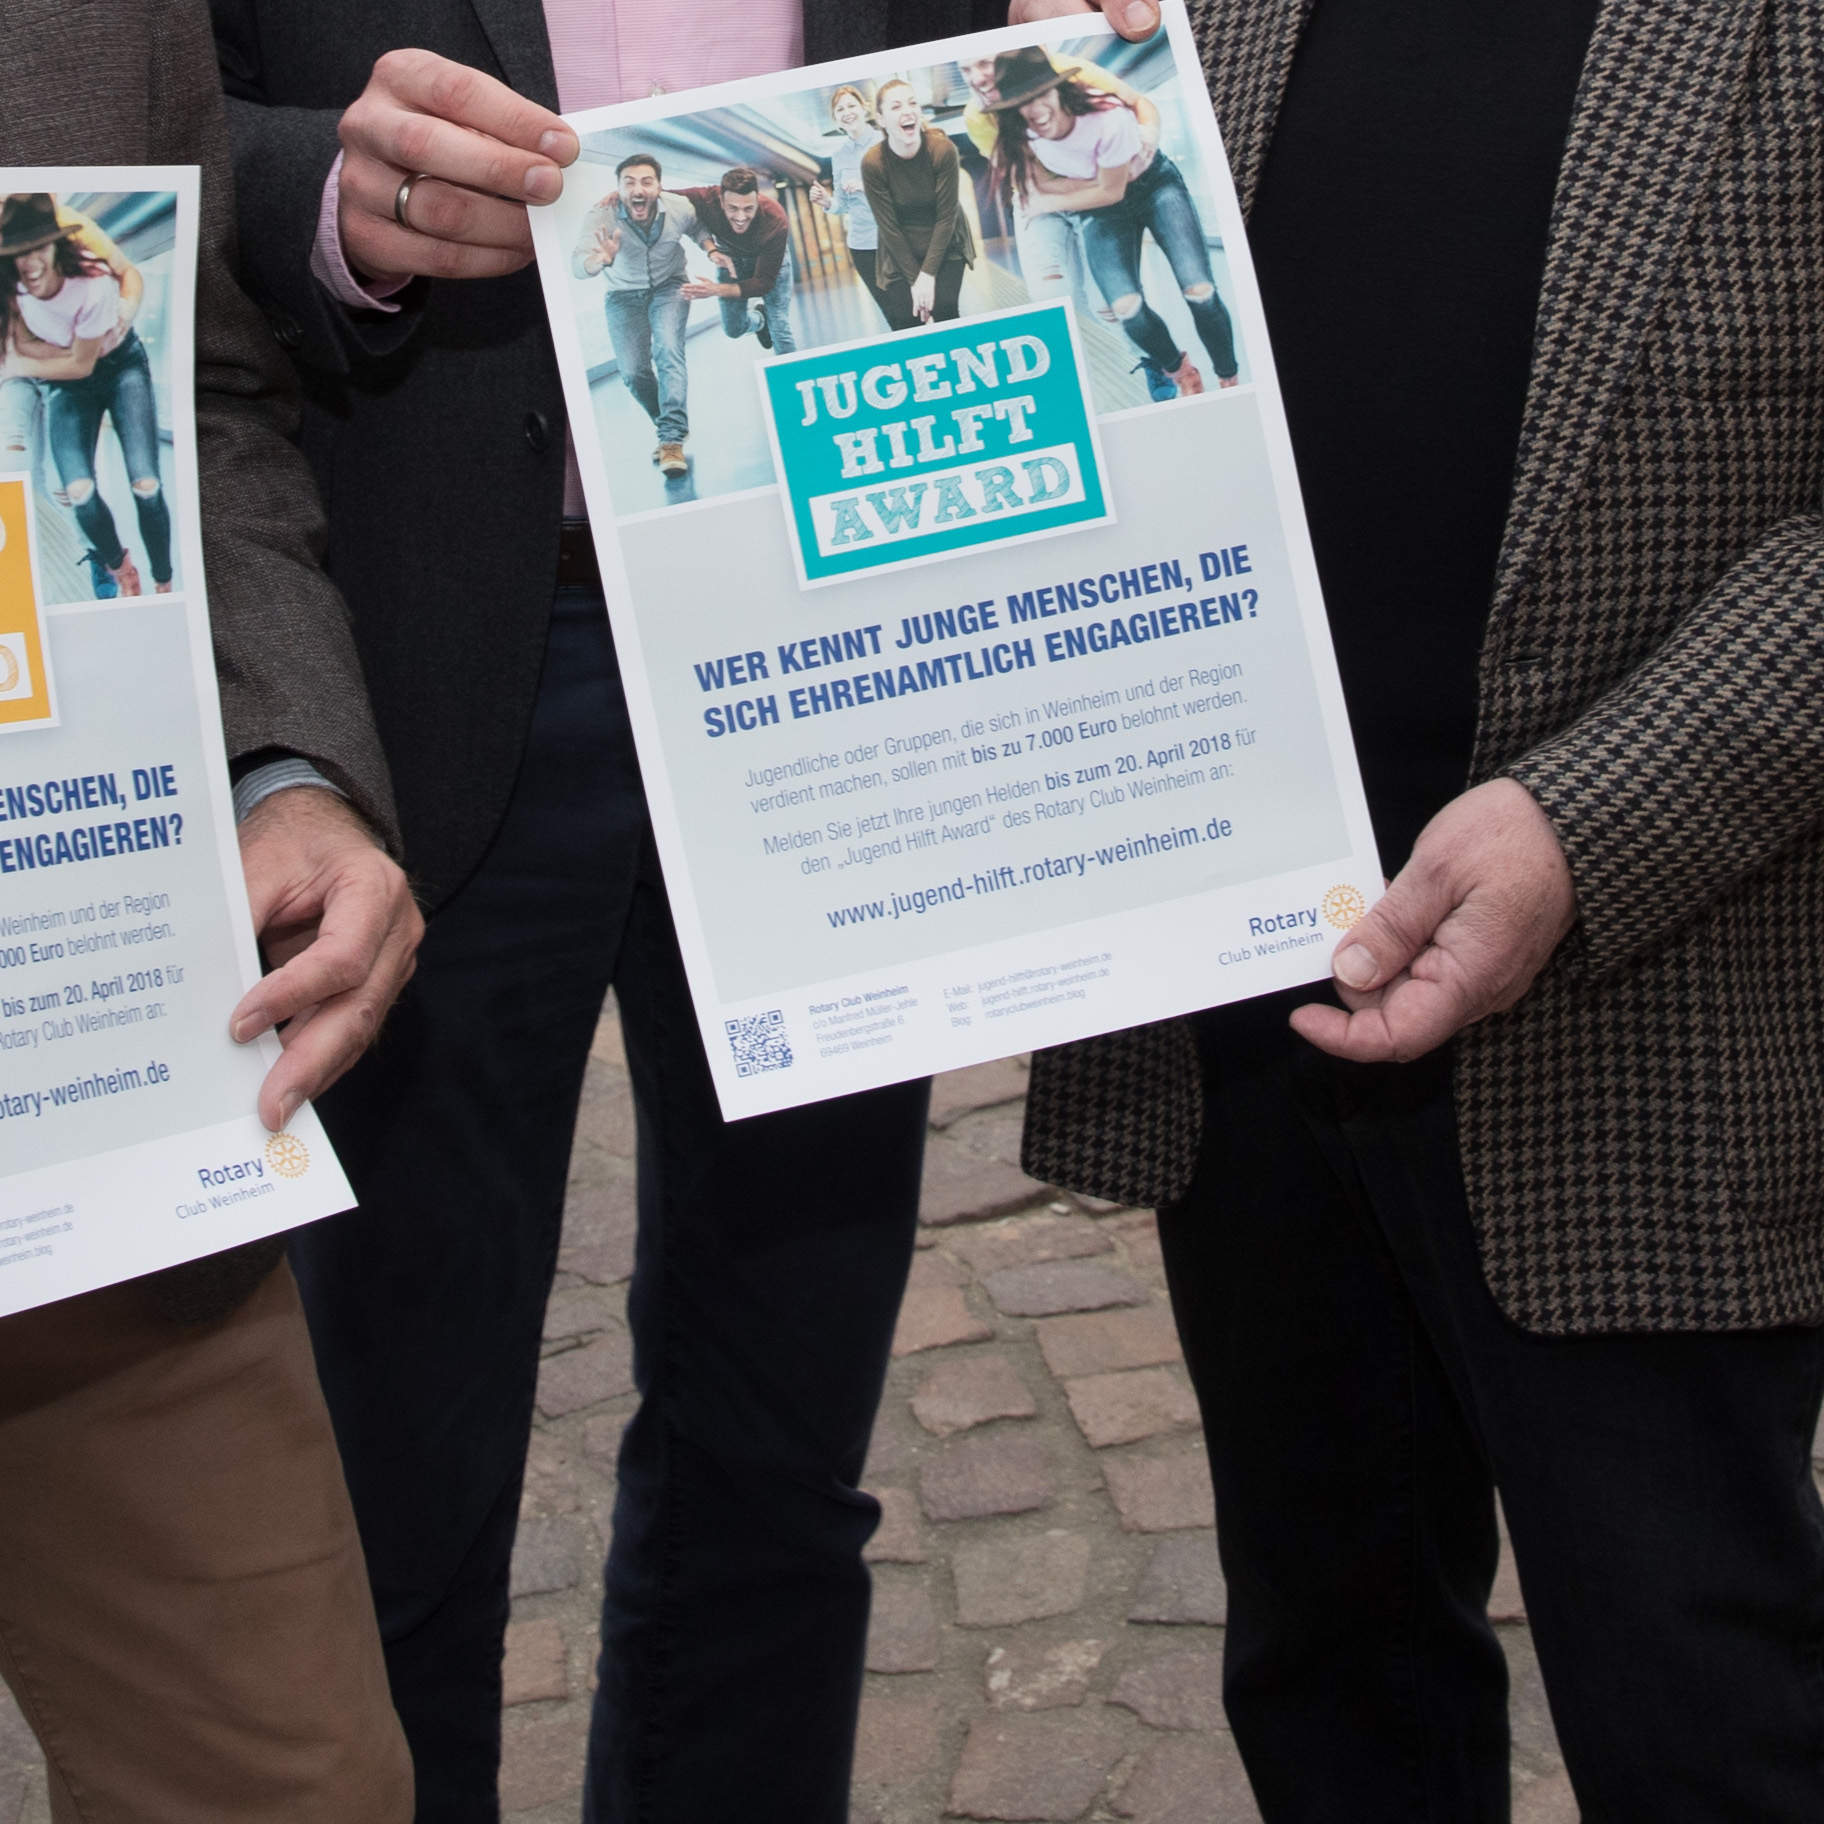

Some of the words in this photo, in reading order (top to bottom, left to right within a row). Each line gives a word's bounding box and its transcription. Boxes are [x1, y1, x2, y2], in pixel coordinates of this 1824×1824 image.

[795, 334, 1052, 427] JUGEND
[832, 394, 1037, 479] HILFT
[830, 456, 1071, 546] AWARD
[693, 650, 770, 693] WER
[777, 624, 883, 675] KENNT
[895, 599, 1000, 650] JUNGE
[1006, 558, 1193, 625] MENSCHEN,
[1198, 544, 1253, 583] DIE
[703, 694, 781, 738] SICH
[787, 637, 1037, 720] EHRENAMTLICH
[1043, 588, 1259, 663] ENGAGIEREN?
[744, 753, 841, 788] Jugendliche
[843, 744, 880, 765] oder
[883, 728, 958, 756] Gruppen,
[960, 719, 985, 739] die
[988, 710, 1022, 733] sich
[1024, 706, 1041, 725] in
[1041, 689, 1122, 720] Weinheim
[1124, 678, 1156, 702] und
[1158, 675, 1185, 695] der
[1187, 663, 1244, 688] Region
[750, 785, 816, 814] verdient
[818, 772, 888, 799] machen,
[891, 759, 938, 783] sollen
[941, 750, 969, 770] mit
[970, 744, 998, 765] bis
[1000, 740, 1023, 758] zu
[1024, 725, 1075, 752] 7.000
[1077, 718, 1118, 740] Euro
[1120, 702, 1181, 730] belohnt
[1182, 690, 1248, 716] werden.
[131, 764, 178, 802] DIE
[762, 829, 823, 855] Melden
[826, 822, 853, 841] Sie
[856, 811, 891, 839] jetzt
[893, 806, 925, 825] Ihre
[928, 793, 983, 822] jungen
[985, 780, 1041, 804] Helden
[1043, 770, 1072, 791] bis
[1074, 763, 1112, 785] zum
[1114, 754, 1143, 775] 20.
[1146, 742, 1186, 769] April
[1188, 732, 1233, 758] 2018
[1235, 728, 1257, 747] für
[800, 855, 832, 876] den
[904, 828, 939, 851] Hilft
[1002, 809, 1032, 829] des
[1033, 797, 1085, 822] Rotary
[1089, 785, 1126, 809] Club
[1126, 769, 1206, 800] Weinheim
[1208, 763, 1235, 781] an:
[826, 817, 1233, 929] www.jugend-hilft.rotary-weinheim.de
[1218, 947, 1252, 966] Club
[1253, 932, 1324, 957] Weinheim
[1248, 907, 1317, 937] Rotary
[175, 1200, 208, 1220] Club
[207, 1182, 275, 1210] Weinheim
[197, 1158, 264, 1189] Rotary
